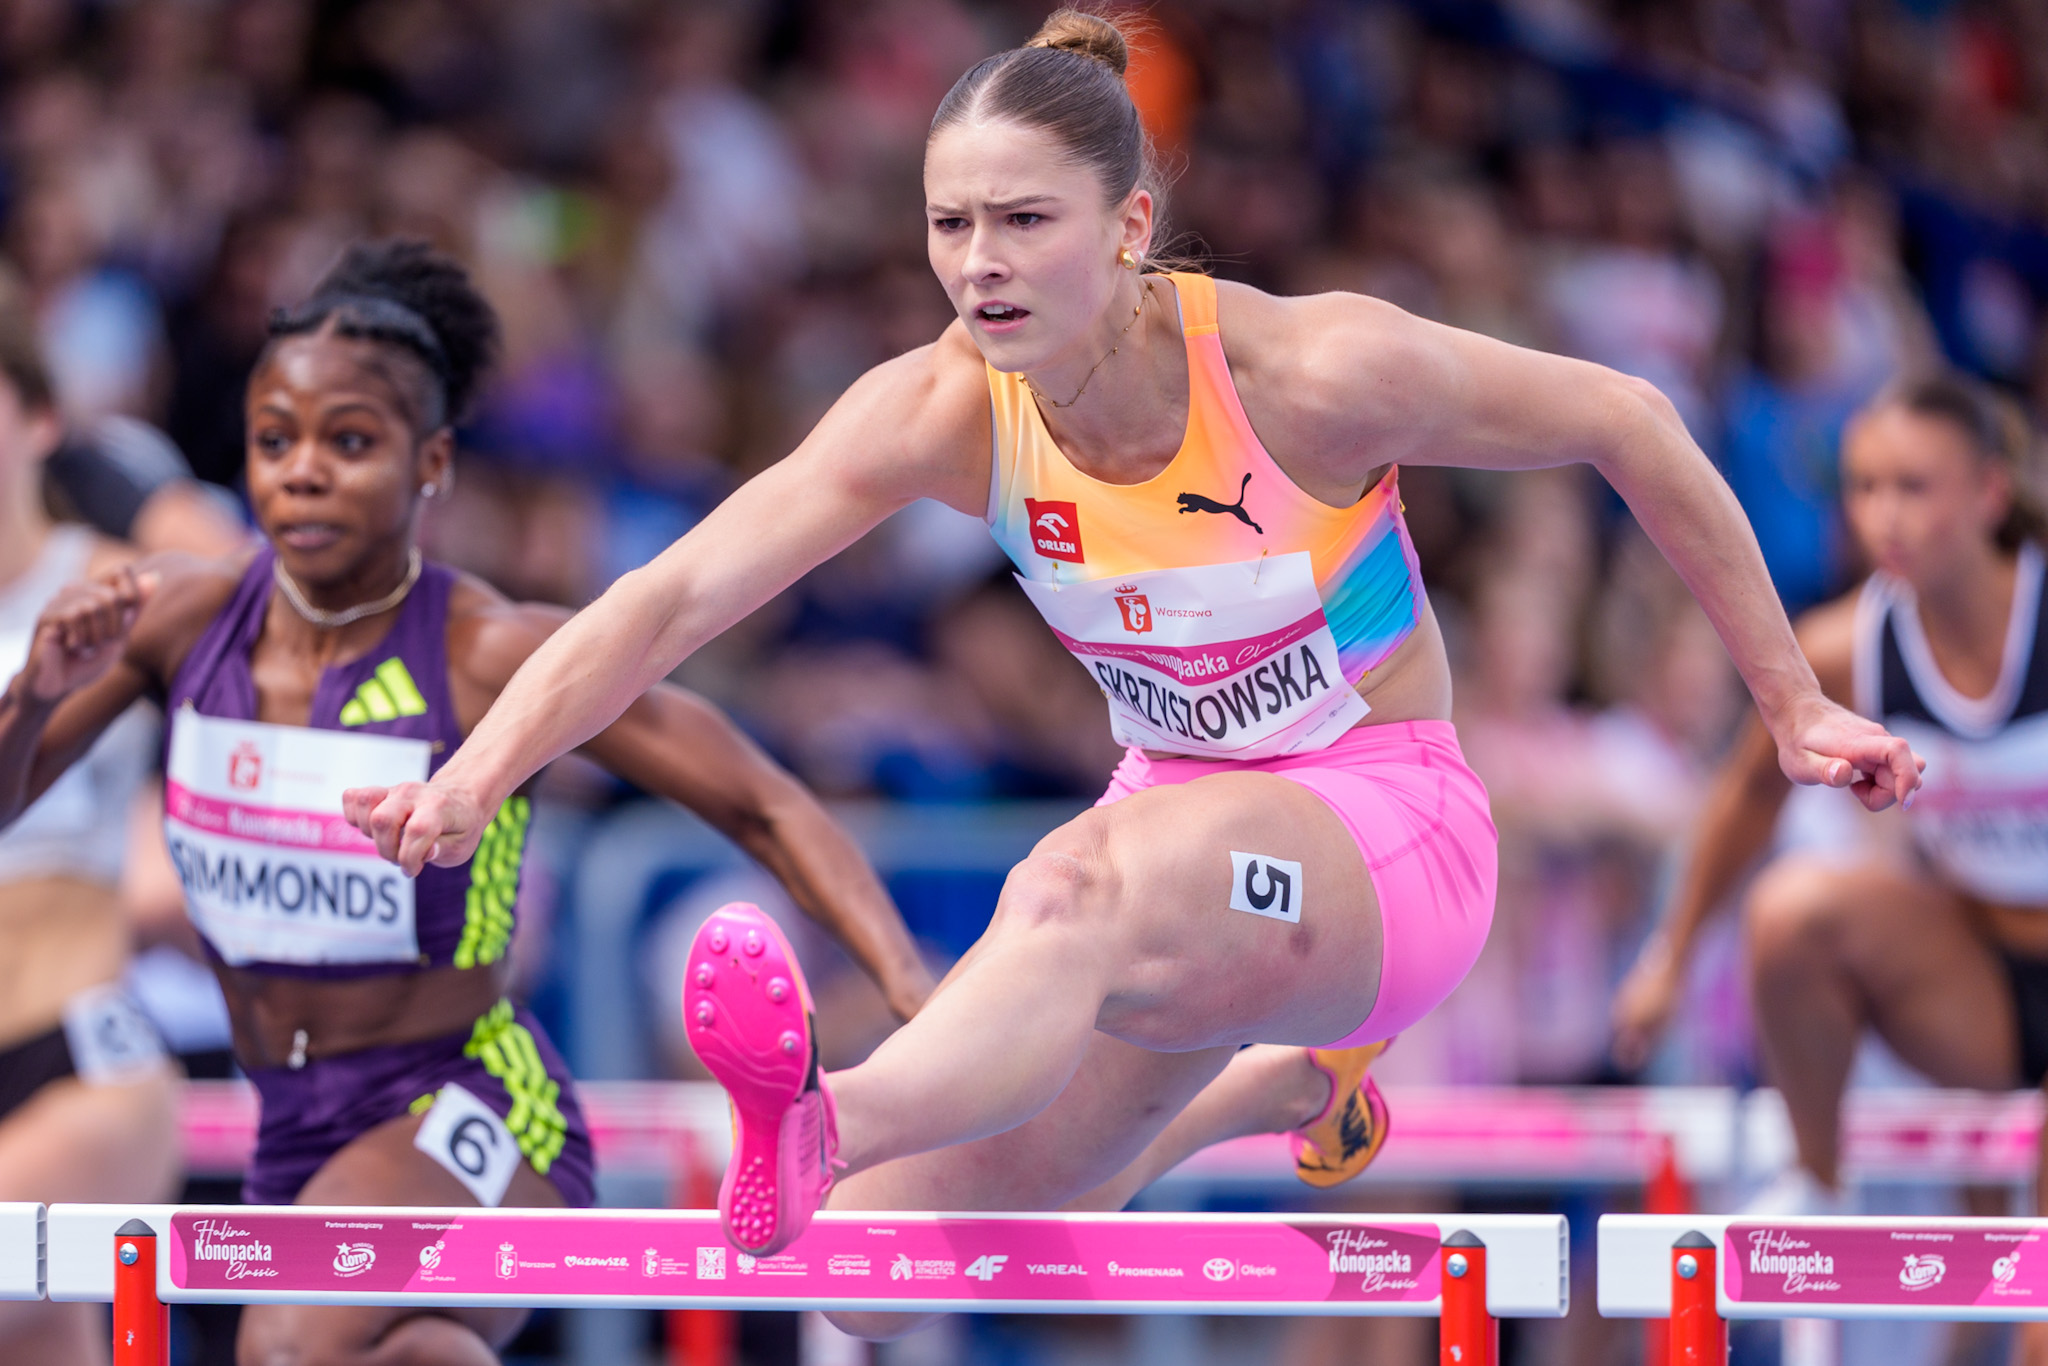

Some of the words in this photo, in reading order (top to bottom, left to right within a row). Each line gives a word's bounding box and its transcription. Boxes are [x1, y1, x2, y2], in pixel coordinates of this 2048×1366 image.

[1037, 538, 1076, 554] ORLEN
[1154, 606, 1213, 619] Warszawa
[1137, 650, 1229, 680] Konopacka
[1095, 644, 1330, 742] SKRZYSZOWSKA
[174, 837, 399, 924] SIMMONDS
[1245, 859, 1291, 913] 5
[450, 1117, 497, 1176] 6
[192, 1219, 251, 1245] Halina
[325, 1221, 347, 1229] Partner
[194, 1239, 272, 1266] Konopacka
[1326, 1229, 1389, 1256] Halina
[1747, 1229, 1811, 1256] Halina
[341, 1252, 368, 1267] LOTTO
[518, 1260, 556, 1269] Warszawa
[827, 1258, 871, 1268] Continental
[914, 1259, 956, 1268] EUROPEAN
[964, 1254, 1009, 1281] 4F
[1026, 1263, 1088, 1275] YAREAL
[1329, 1249, 1412, 1277] Konopacka
[1750, 1249, 1834, 1279] Konopacka
[225, 1261, 279, 1281] Classic
[828, 1266, 843, 1276] Tour
[844, 1266, 871, 1276] Bronze
[914, 1267, 956, 1275] ATHLETICS
[1118, 1267, 1184, 1278] PROMENADA
[1240, 1264, 1277, 1278] Okęcie
[1361, 1272, 1419, 1293] Classic
[1782, 1273, 1842, 1295] Classic
